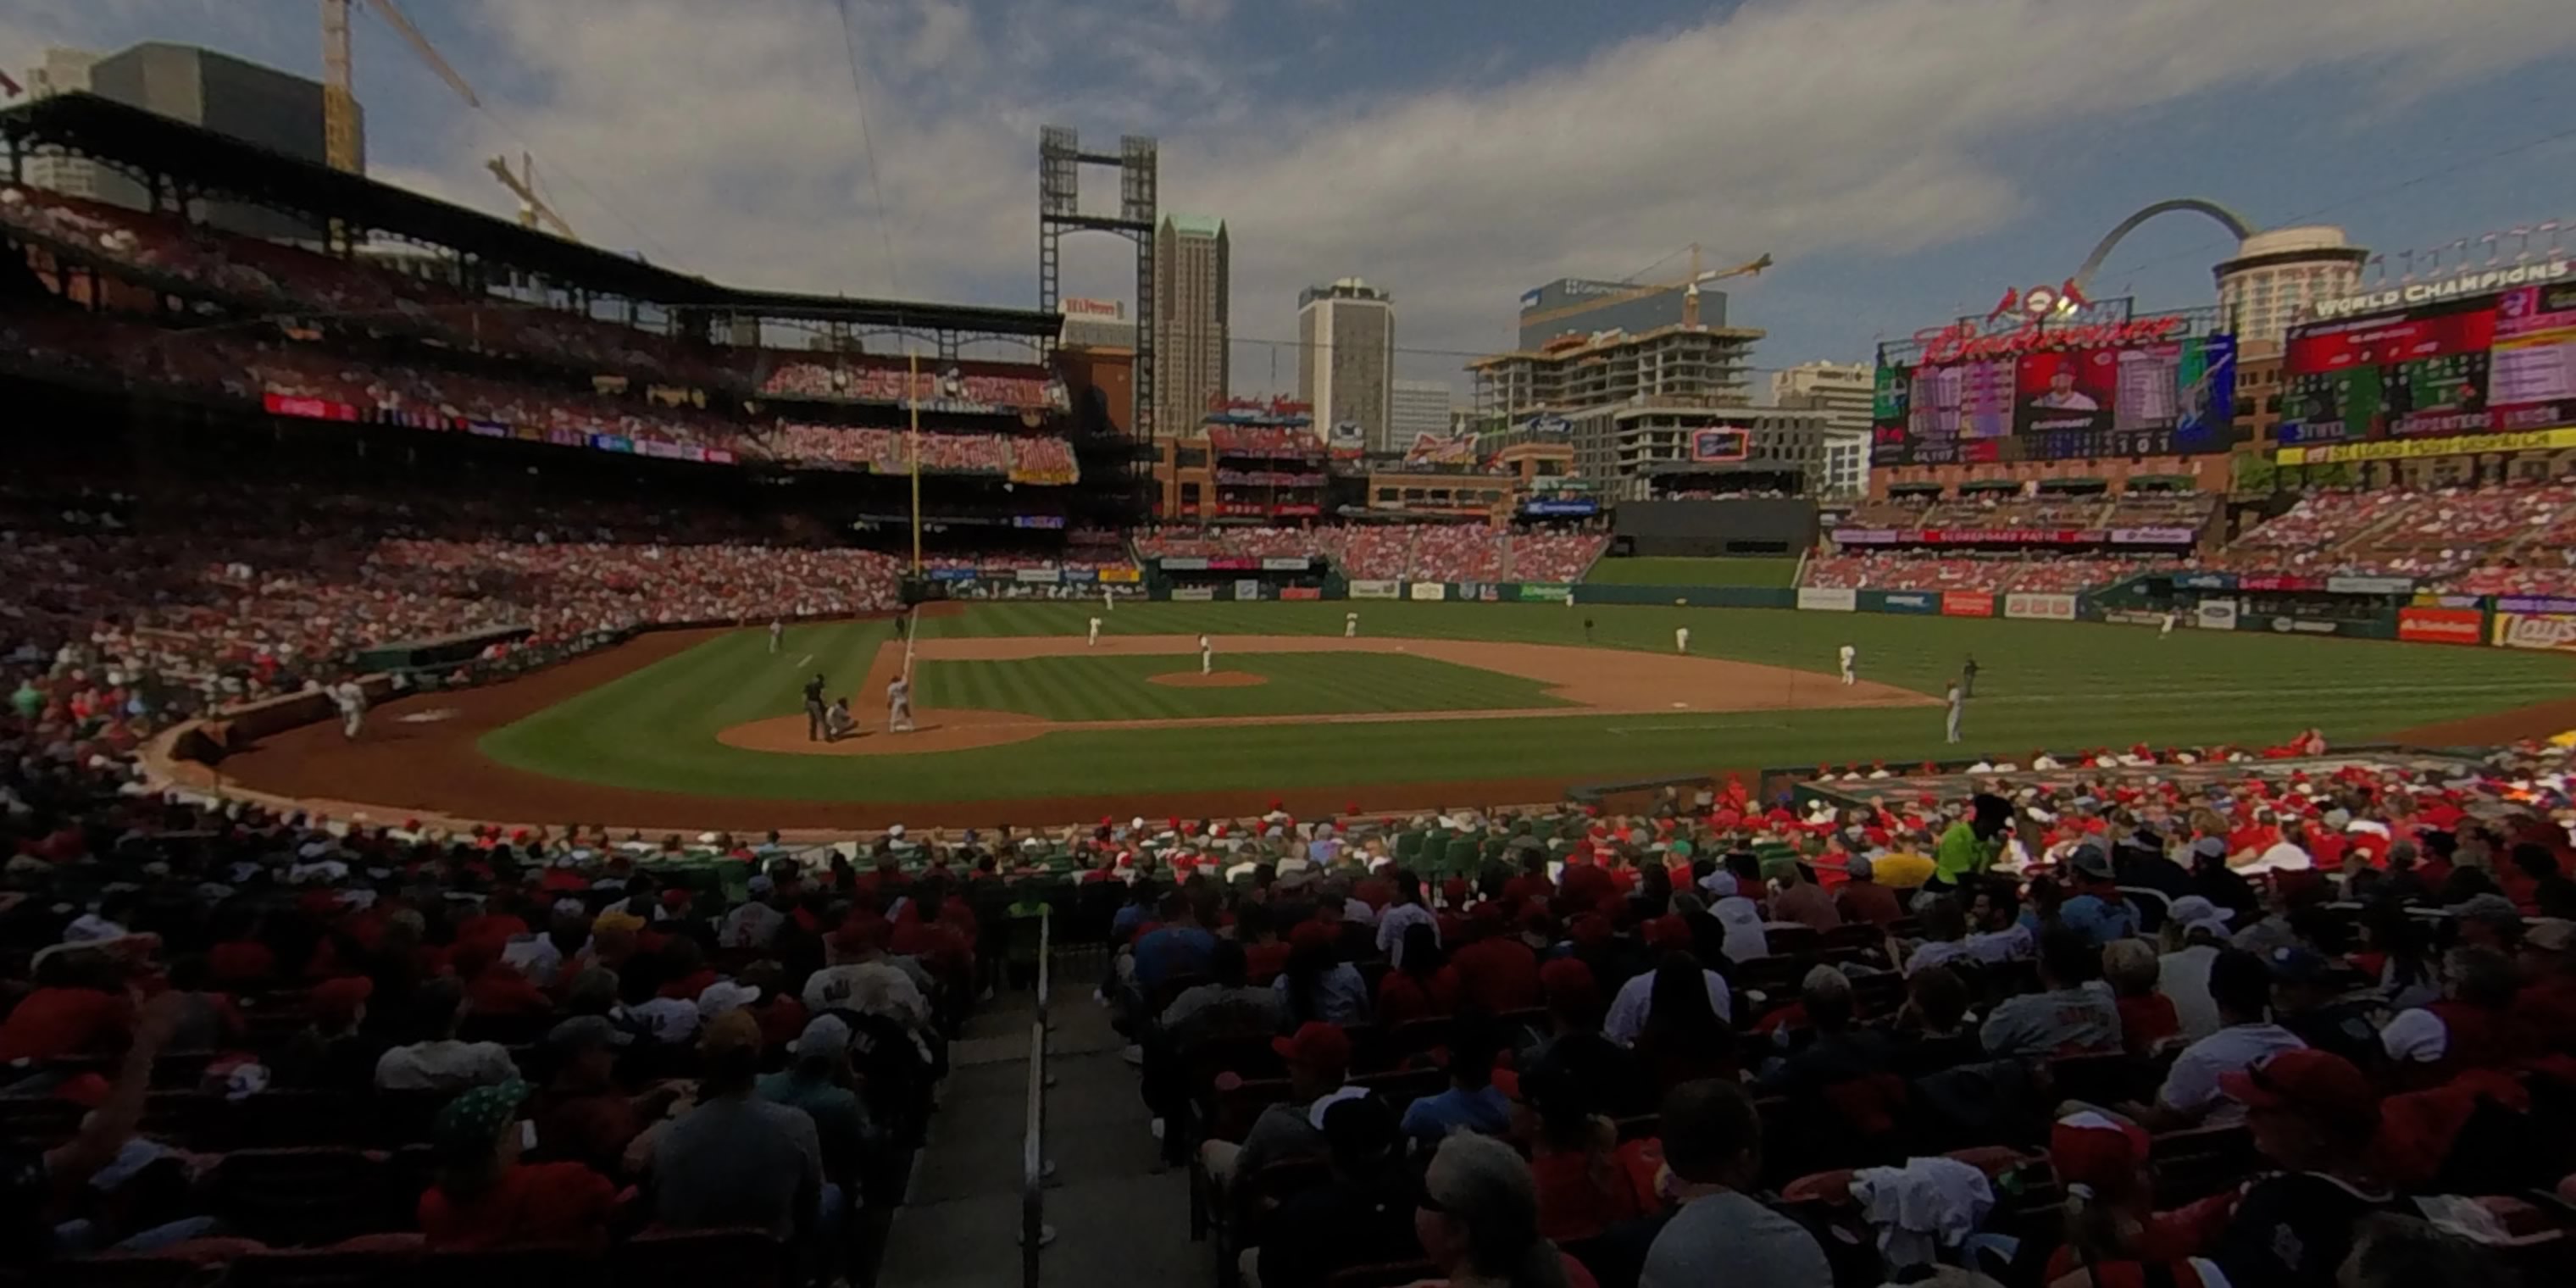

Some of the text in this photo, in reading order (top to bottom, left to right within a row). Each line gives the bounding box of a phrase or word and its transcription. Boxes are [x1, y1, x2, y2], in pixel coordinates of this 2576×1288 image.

[2317, 262, 2568, 317] WORLD CHAMPIONS
[1913, 314, 2183, 365] Budweiser
[2390, 411, 2495, 435] CARPENTERS
